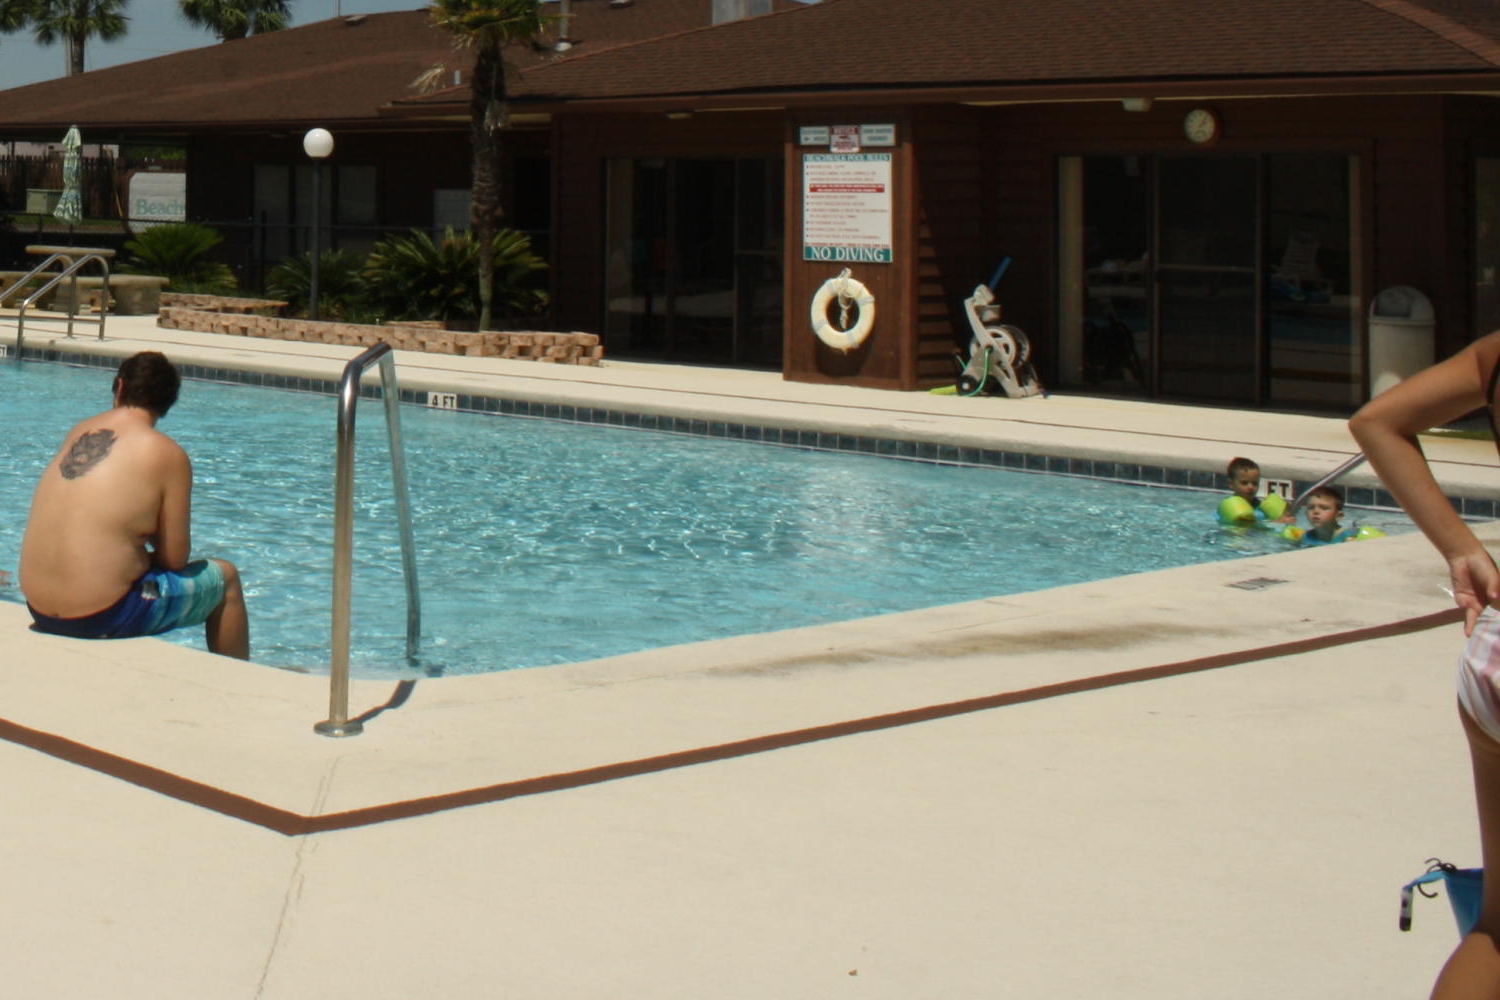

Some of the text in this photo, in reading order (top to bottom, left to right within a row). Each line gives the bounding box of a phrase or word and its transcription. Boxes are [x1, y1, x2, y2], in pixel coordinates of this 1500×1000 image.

[811, 246, 884, 261] NO DIVING
[443, 395, 455, 407] FT
